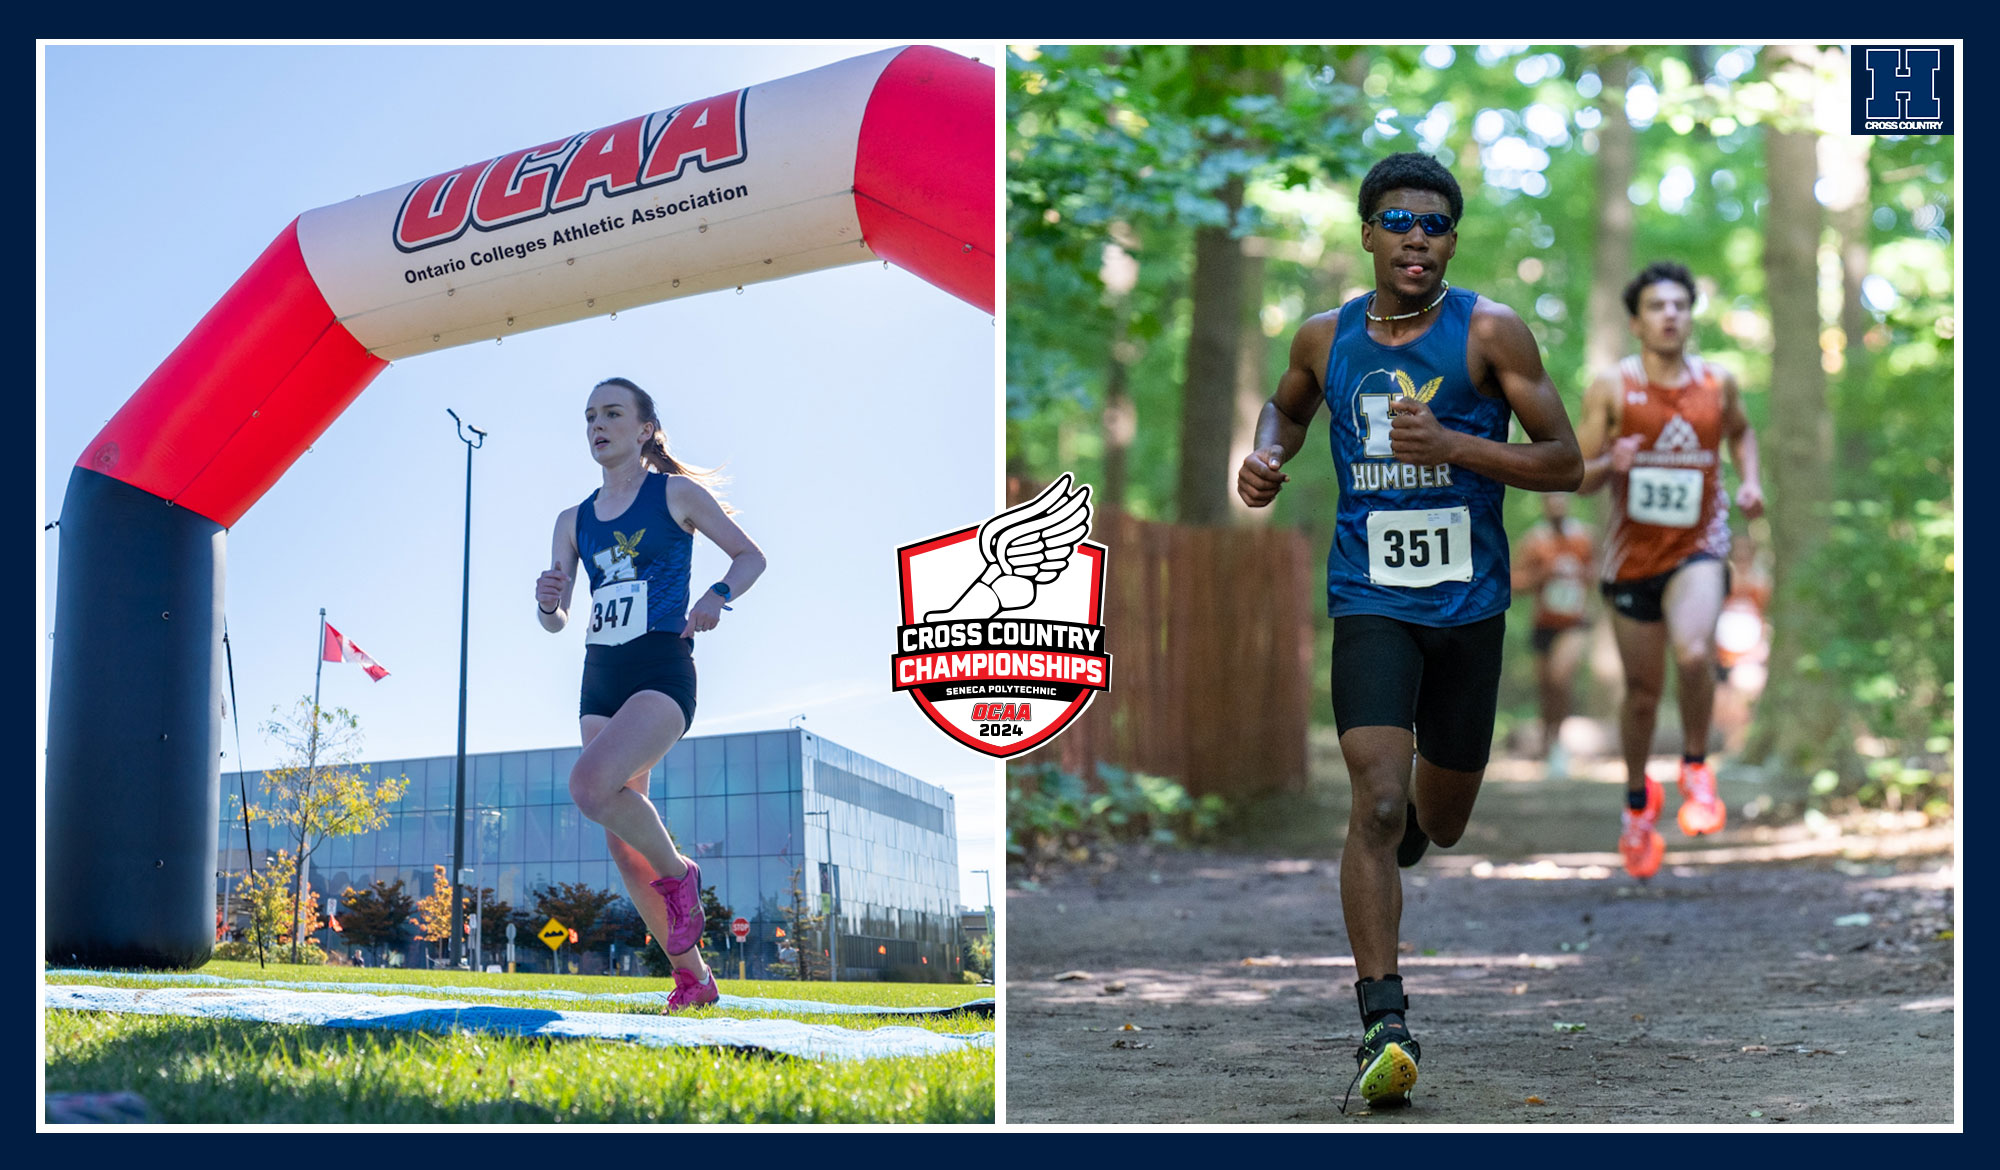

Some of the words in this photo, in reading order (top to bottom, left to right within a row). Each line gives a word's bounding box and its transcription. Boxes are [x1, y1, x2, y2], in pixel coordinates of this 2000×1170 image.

[392, 87, 750, 254] OCAA
[404, 257, 466, 285] Ontario
[470, 236, 547, 269] Colleges
[552, 213, 626, 247] Athletic
[631, 184, 749, 226] Association
[1351, 462, 1453, 490] HUMBER
[1641, 482, 1689, 511] 392
[1383, 527, 1450, 568] 351
[592, 596, 634, 633] 347
[732, 923, 749, 931] STOP
